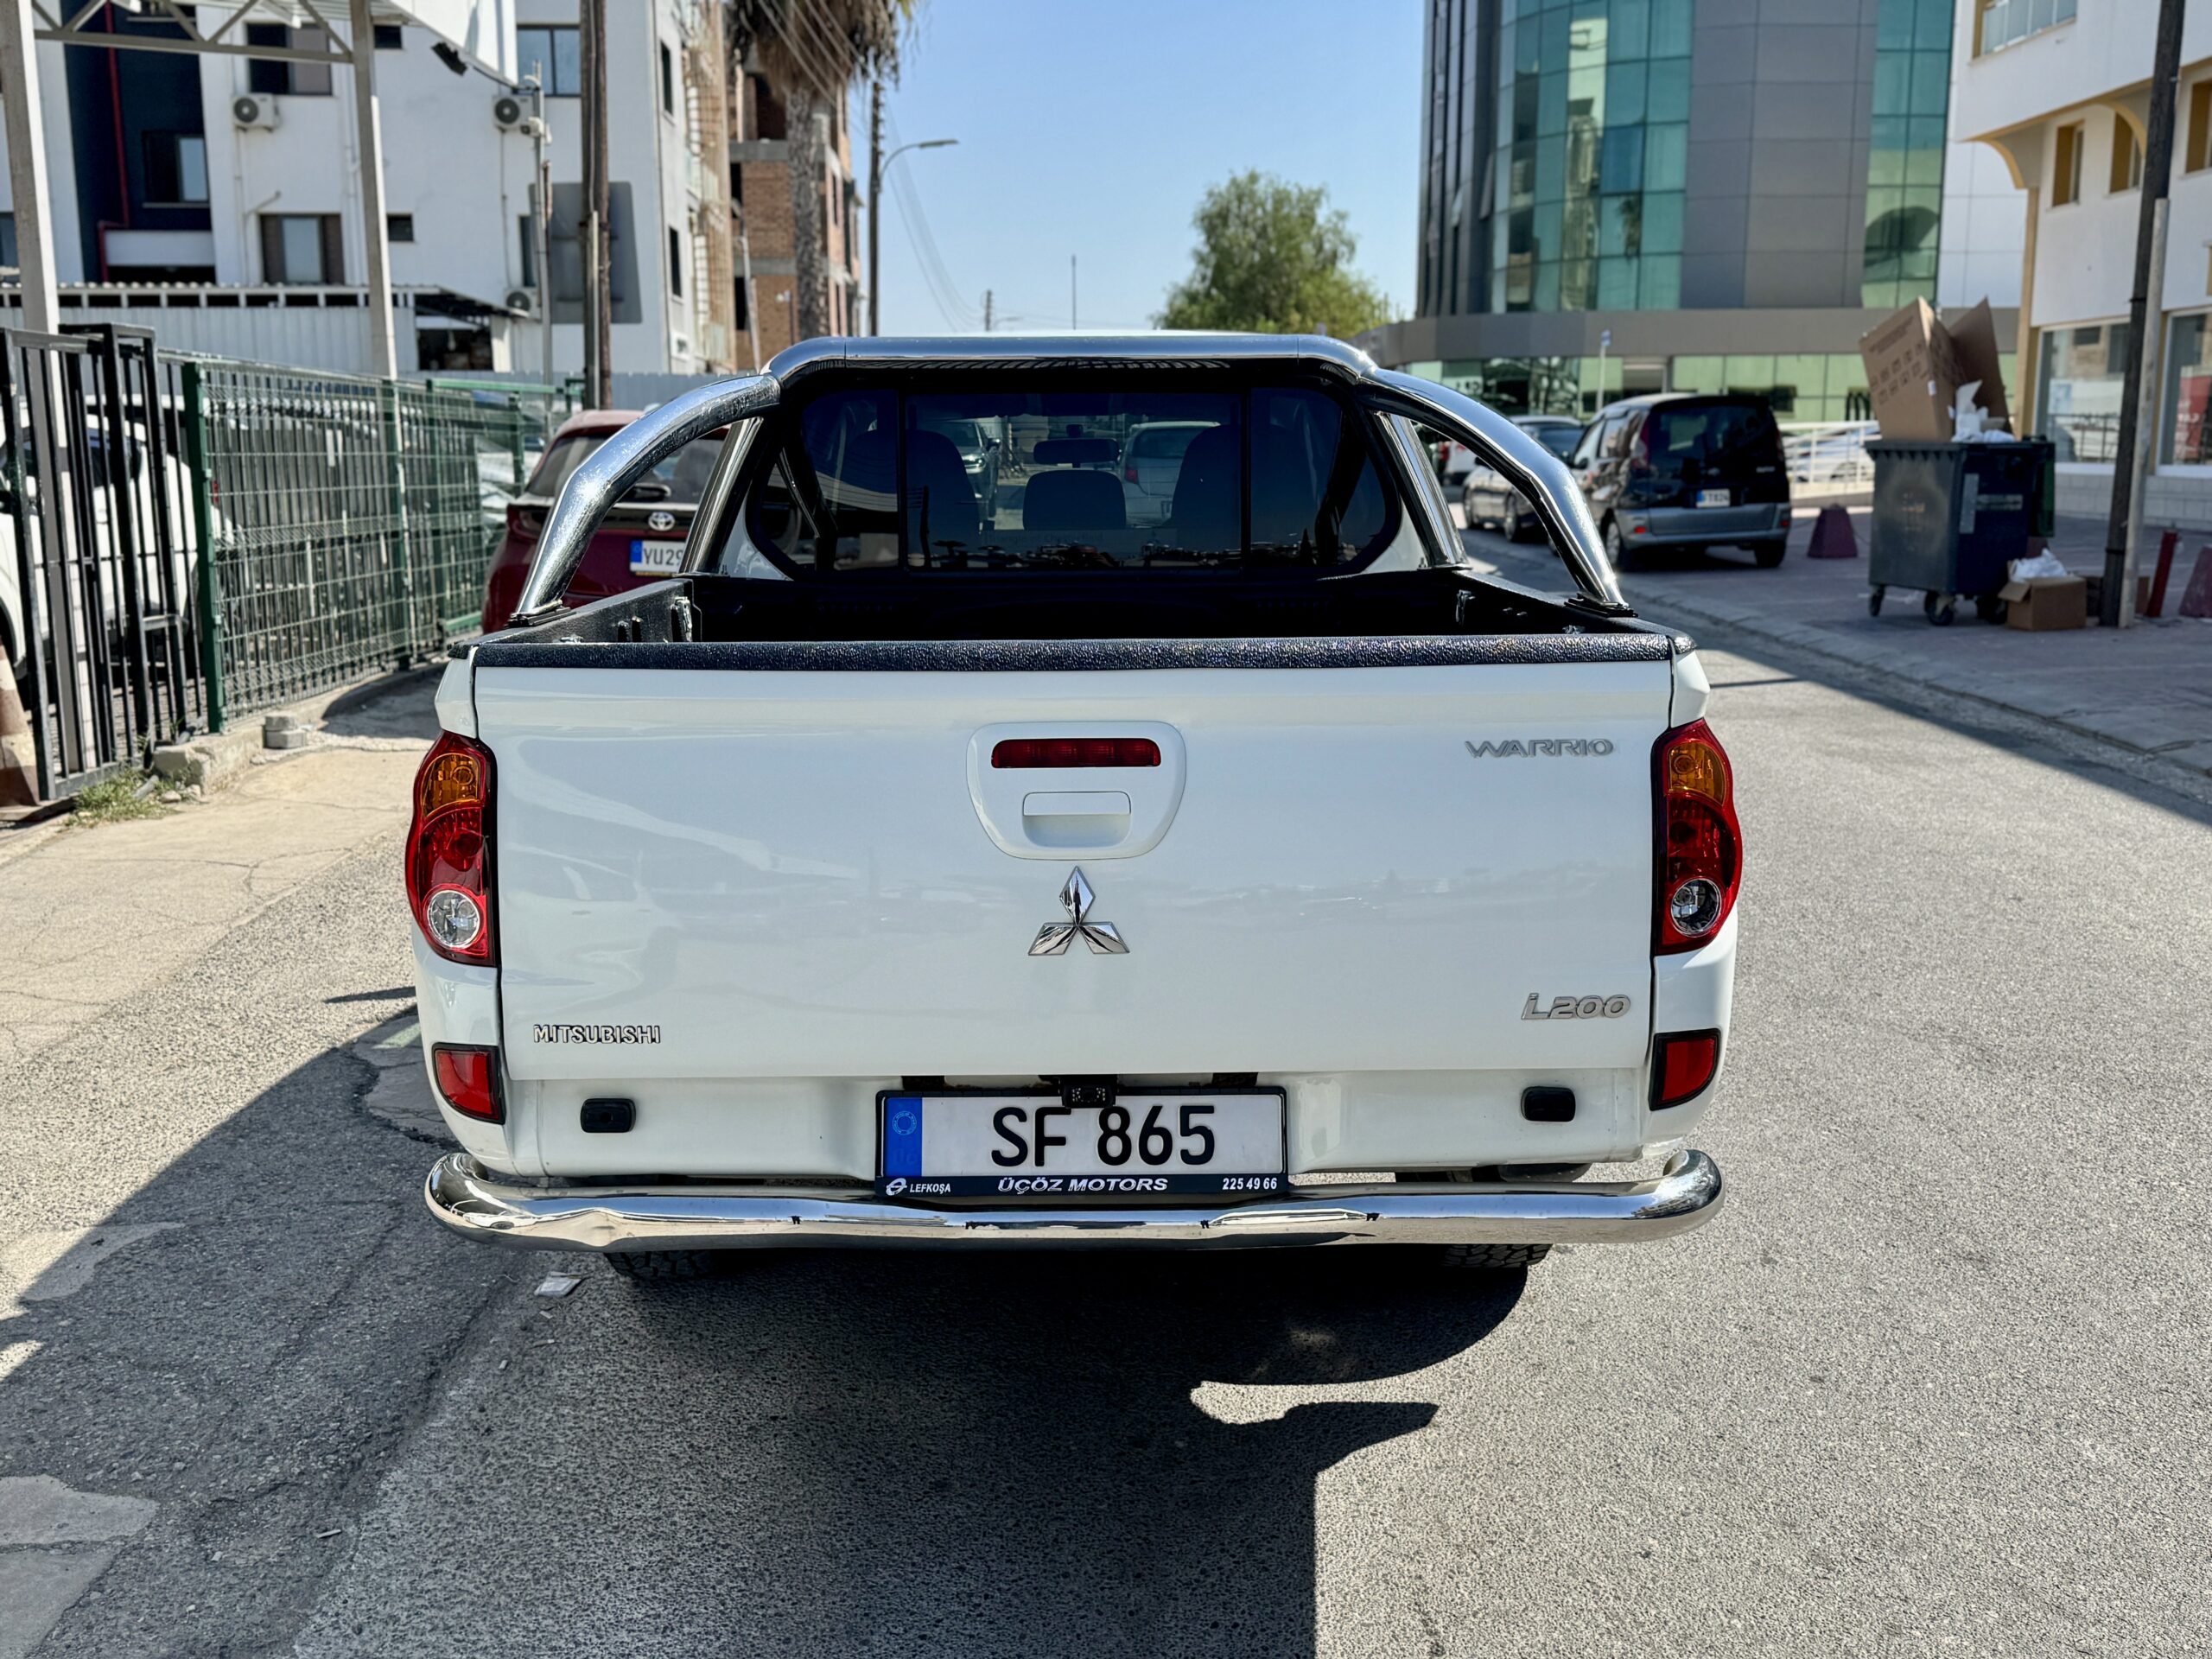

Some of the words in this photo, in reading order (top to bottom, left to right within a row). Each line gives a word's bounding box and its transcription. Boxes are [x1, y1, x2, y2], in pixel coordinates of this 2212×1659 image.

[1465, 738, 1614, 759] WARRIO
[1521, 993, 1631, 1020] L200
[533, 1024, 661, 1044] MITSUBISHI
[991, 1106, 1072, 1166] SF
[1096, 1105, 1215, 1166] 865
[910, 1183, 951, 1194] LEFKOŞA
[997, 1177, 1064, 1194] ÜÇÖZ
[1068, 1178, 1168, 1192] MOTORS
[1222, 1177, 1244, 1191] 225
[1246, 1177, 1261, 1191] 49
[1262, 1177, 1278, 1191] 66
